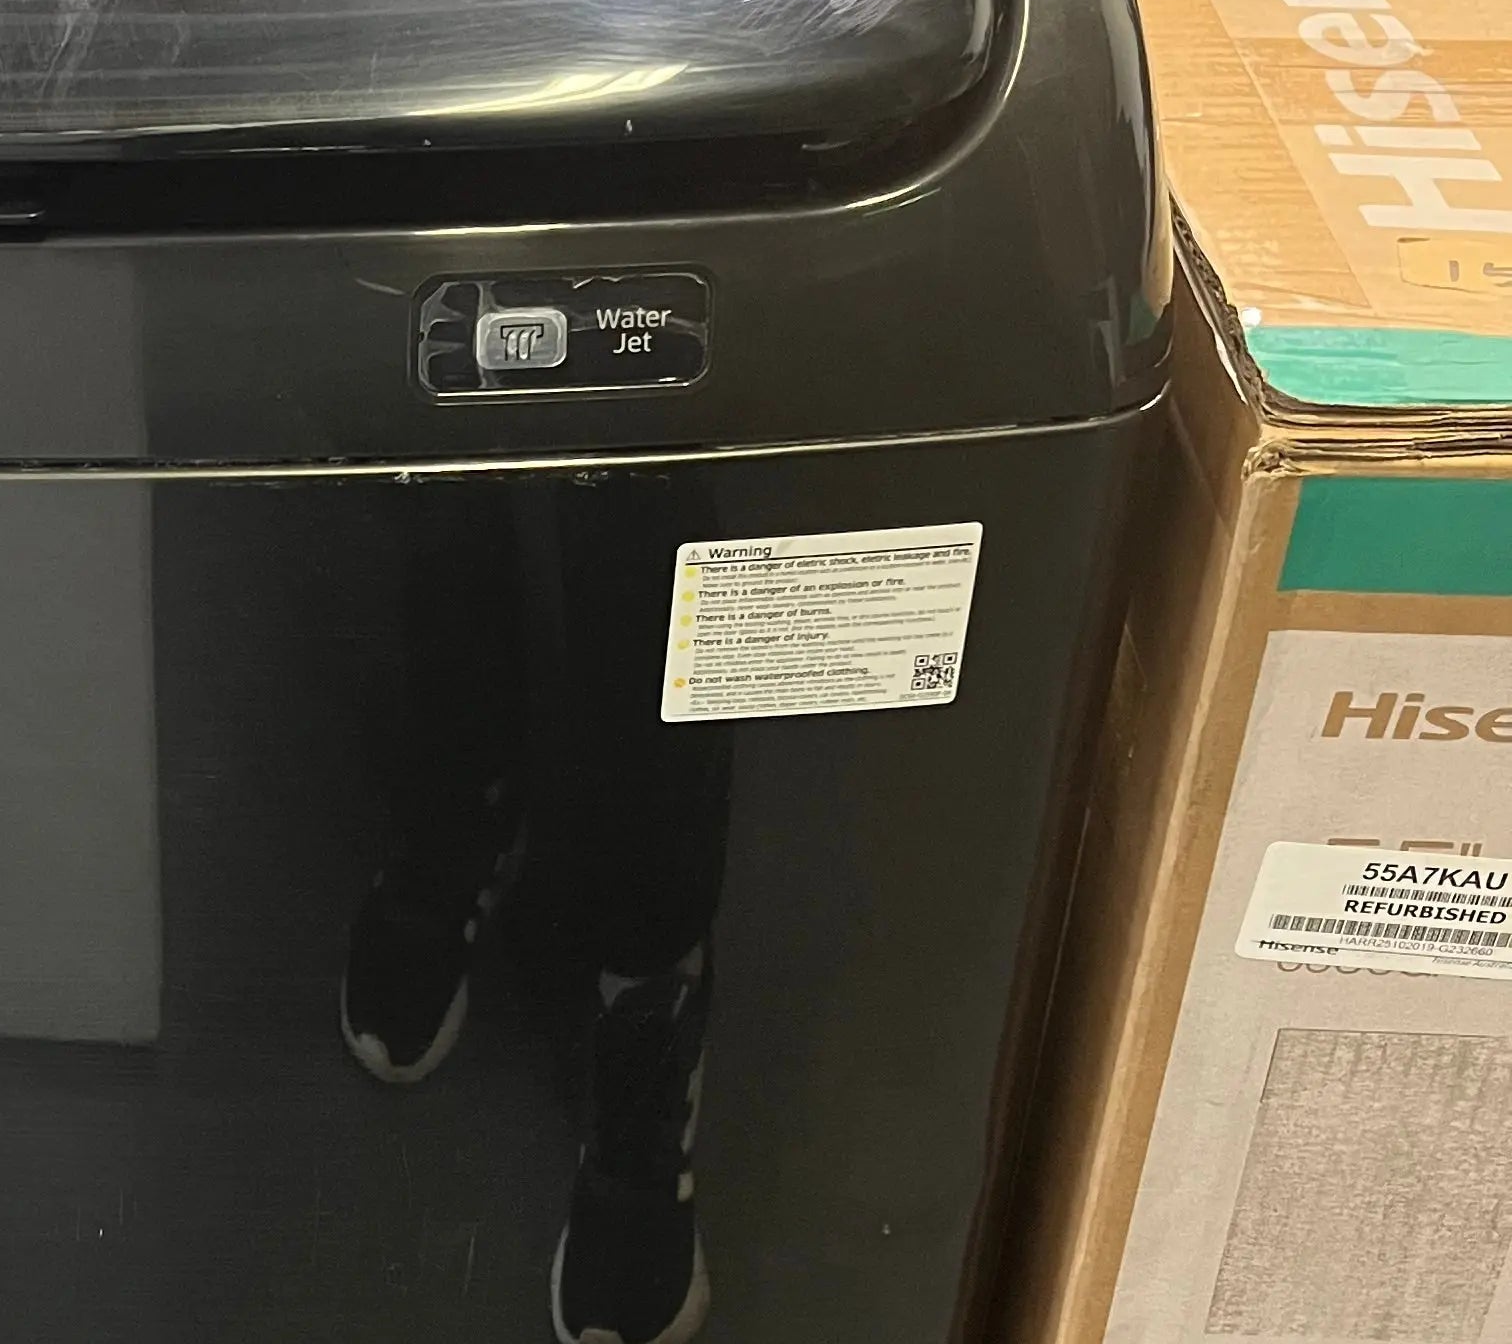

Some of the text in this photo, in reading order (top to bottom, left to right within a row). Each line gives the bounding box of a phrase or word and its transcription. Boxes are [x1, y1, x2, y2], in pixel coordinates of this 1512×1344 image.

[596, 307, 672, 330] Water
[613, 332, 652, 355] Jet
[709, 546, 772, 560] Warning
[698, 590, 727, 598] There
[750, 586, 787, 596] danger
[696, 614, 725, 622] There
[747, 610, 784, 620] danger
[693, 639, 722, 647] There
[745, 635, 781, 644] danger
[689, 677, 702, 685] Do
[1321, 690, 1512, 744] Hise
[1362, 862, 1509, 891] 55A7KAU
[1344, 899, 1508, 926] REFURBISHED
[1259, 939, 1339, 956] Hisense
